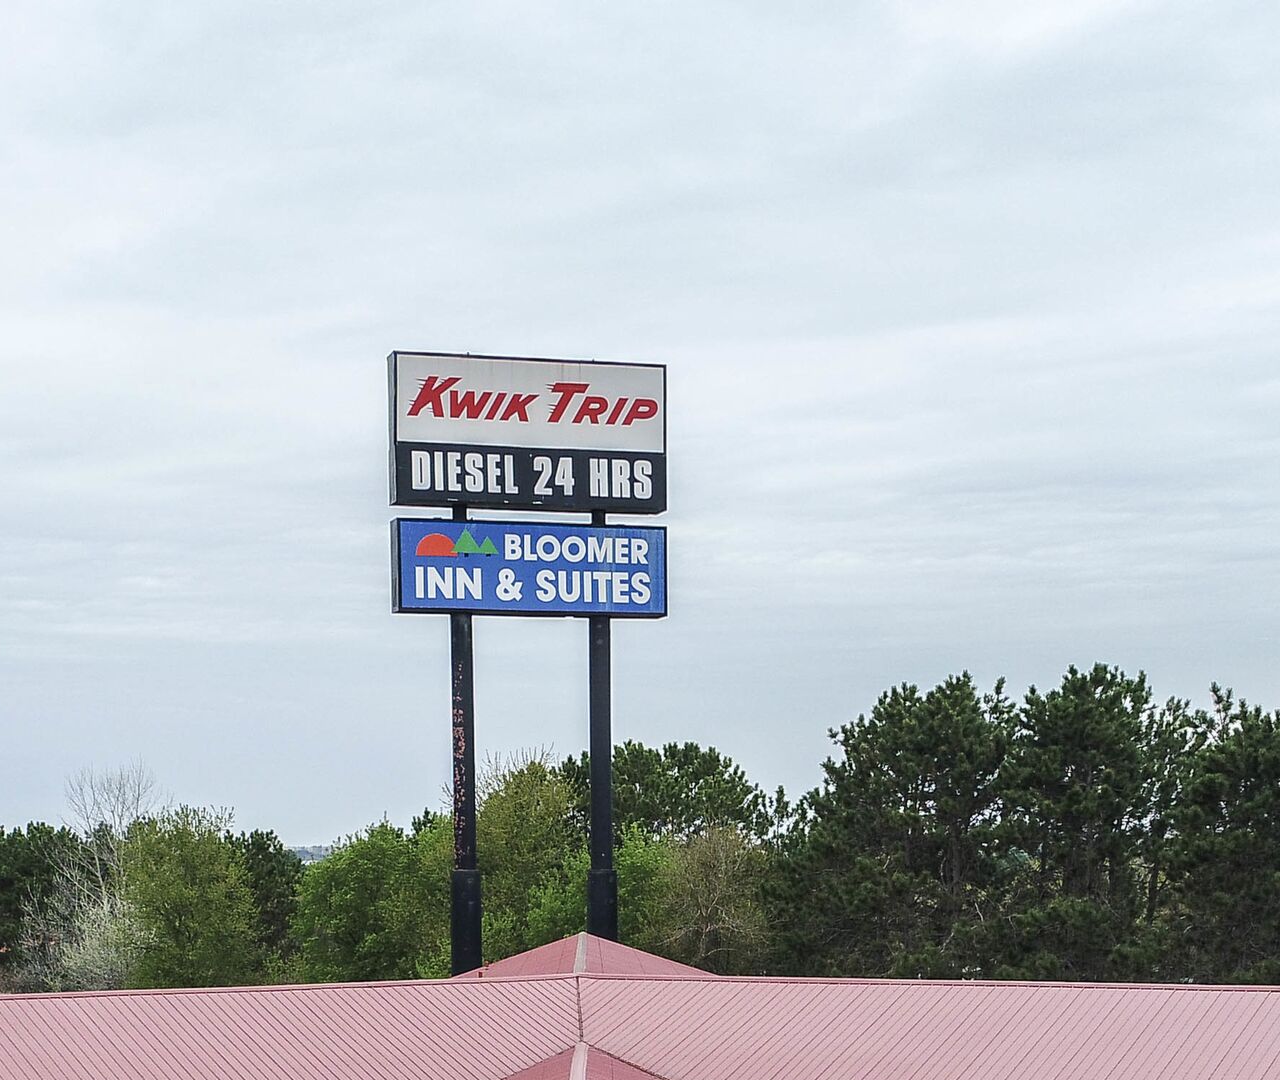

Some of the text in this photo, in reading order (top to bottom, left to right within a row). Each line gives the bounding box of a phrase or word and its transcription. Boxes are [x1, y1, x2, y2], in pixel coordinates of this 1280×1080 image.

[411, 450, 653, 499] DIESEL 24 HRS
[504, 533, 648, 565] BLOOMER
[415, 566, 651, 604] INN & SUITES
